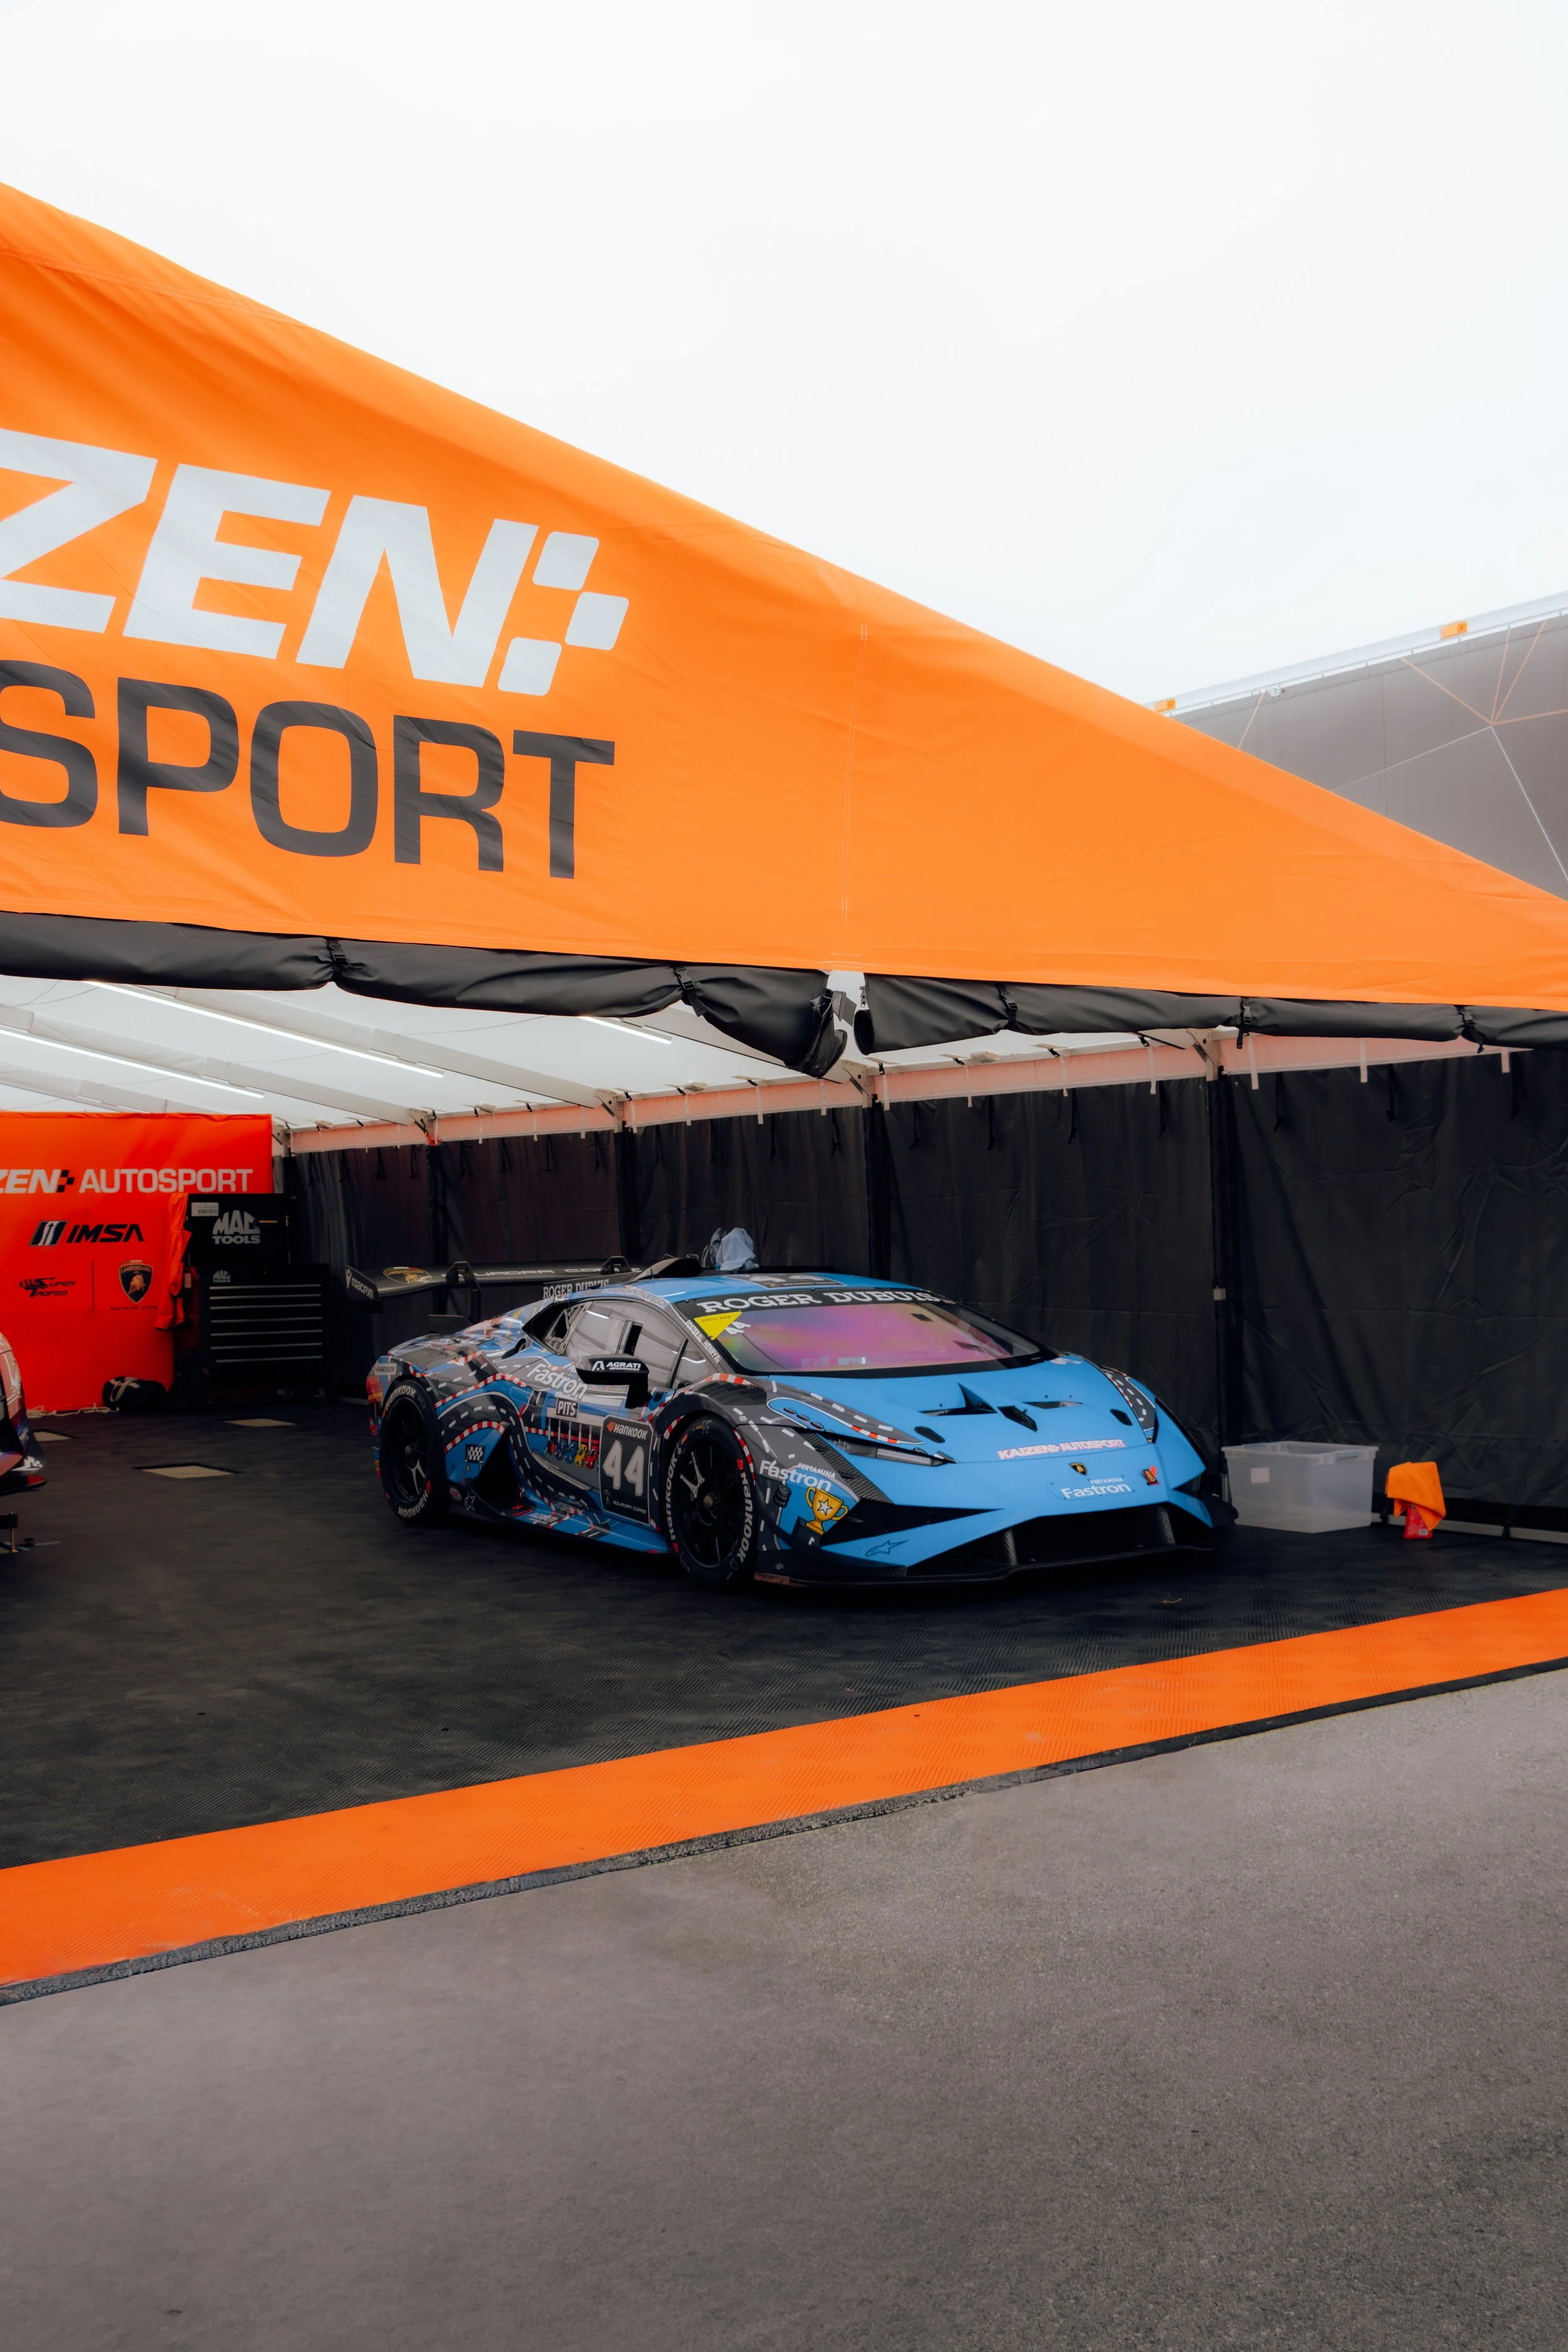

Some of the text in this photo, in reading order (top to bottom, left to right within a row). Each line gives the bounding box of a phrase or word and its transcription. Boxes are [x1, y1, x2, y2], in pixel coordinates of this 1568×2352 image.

[79, 1168, 253, 1194] AUTOSPORT
[212, 1209, 261, 1235] MAC
[66, 1224, 144, 1244] IMSA
[212, 1235, 261, 1245] TOOLS
[441, 1269, 554, 1278] UADRA
[351, 1276, 374, 1300] macron
[697, 1290, 941, 1313] ROGER DUBUIS
[701, 1315, 733, 1323] PRO-AM
[702, 1340, 719, 1358] HENRY
[527, 1362, 588, 1401] Fastron
[557, 1400, 577, 1417] PITS
[997, 1439, 1126, 1460] KAIZEN AUTOSPORT
[602, 1439, 645, 1496] 44
[759, 1459, 832, 1492] Fastron
[797, 1462, 836, 1480] PERTAMINA
[1061, 1483, 1132, 1499] Fastron
[1089, 1477, 1124, 1485] PERTAMINA
